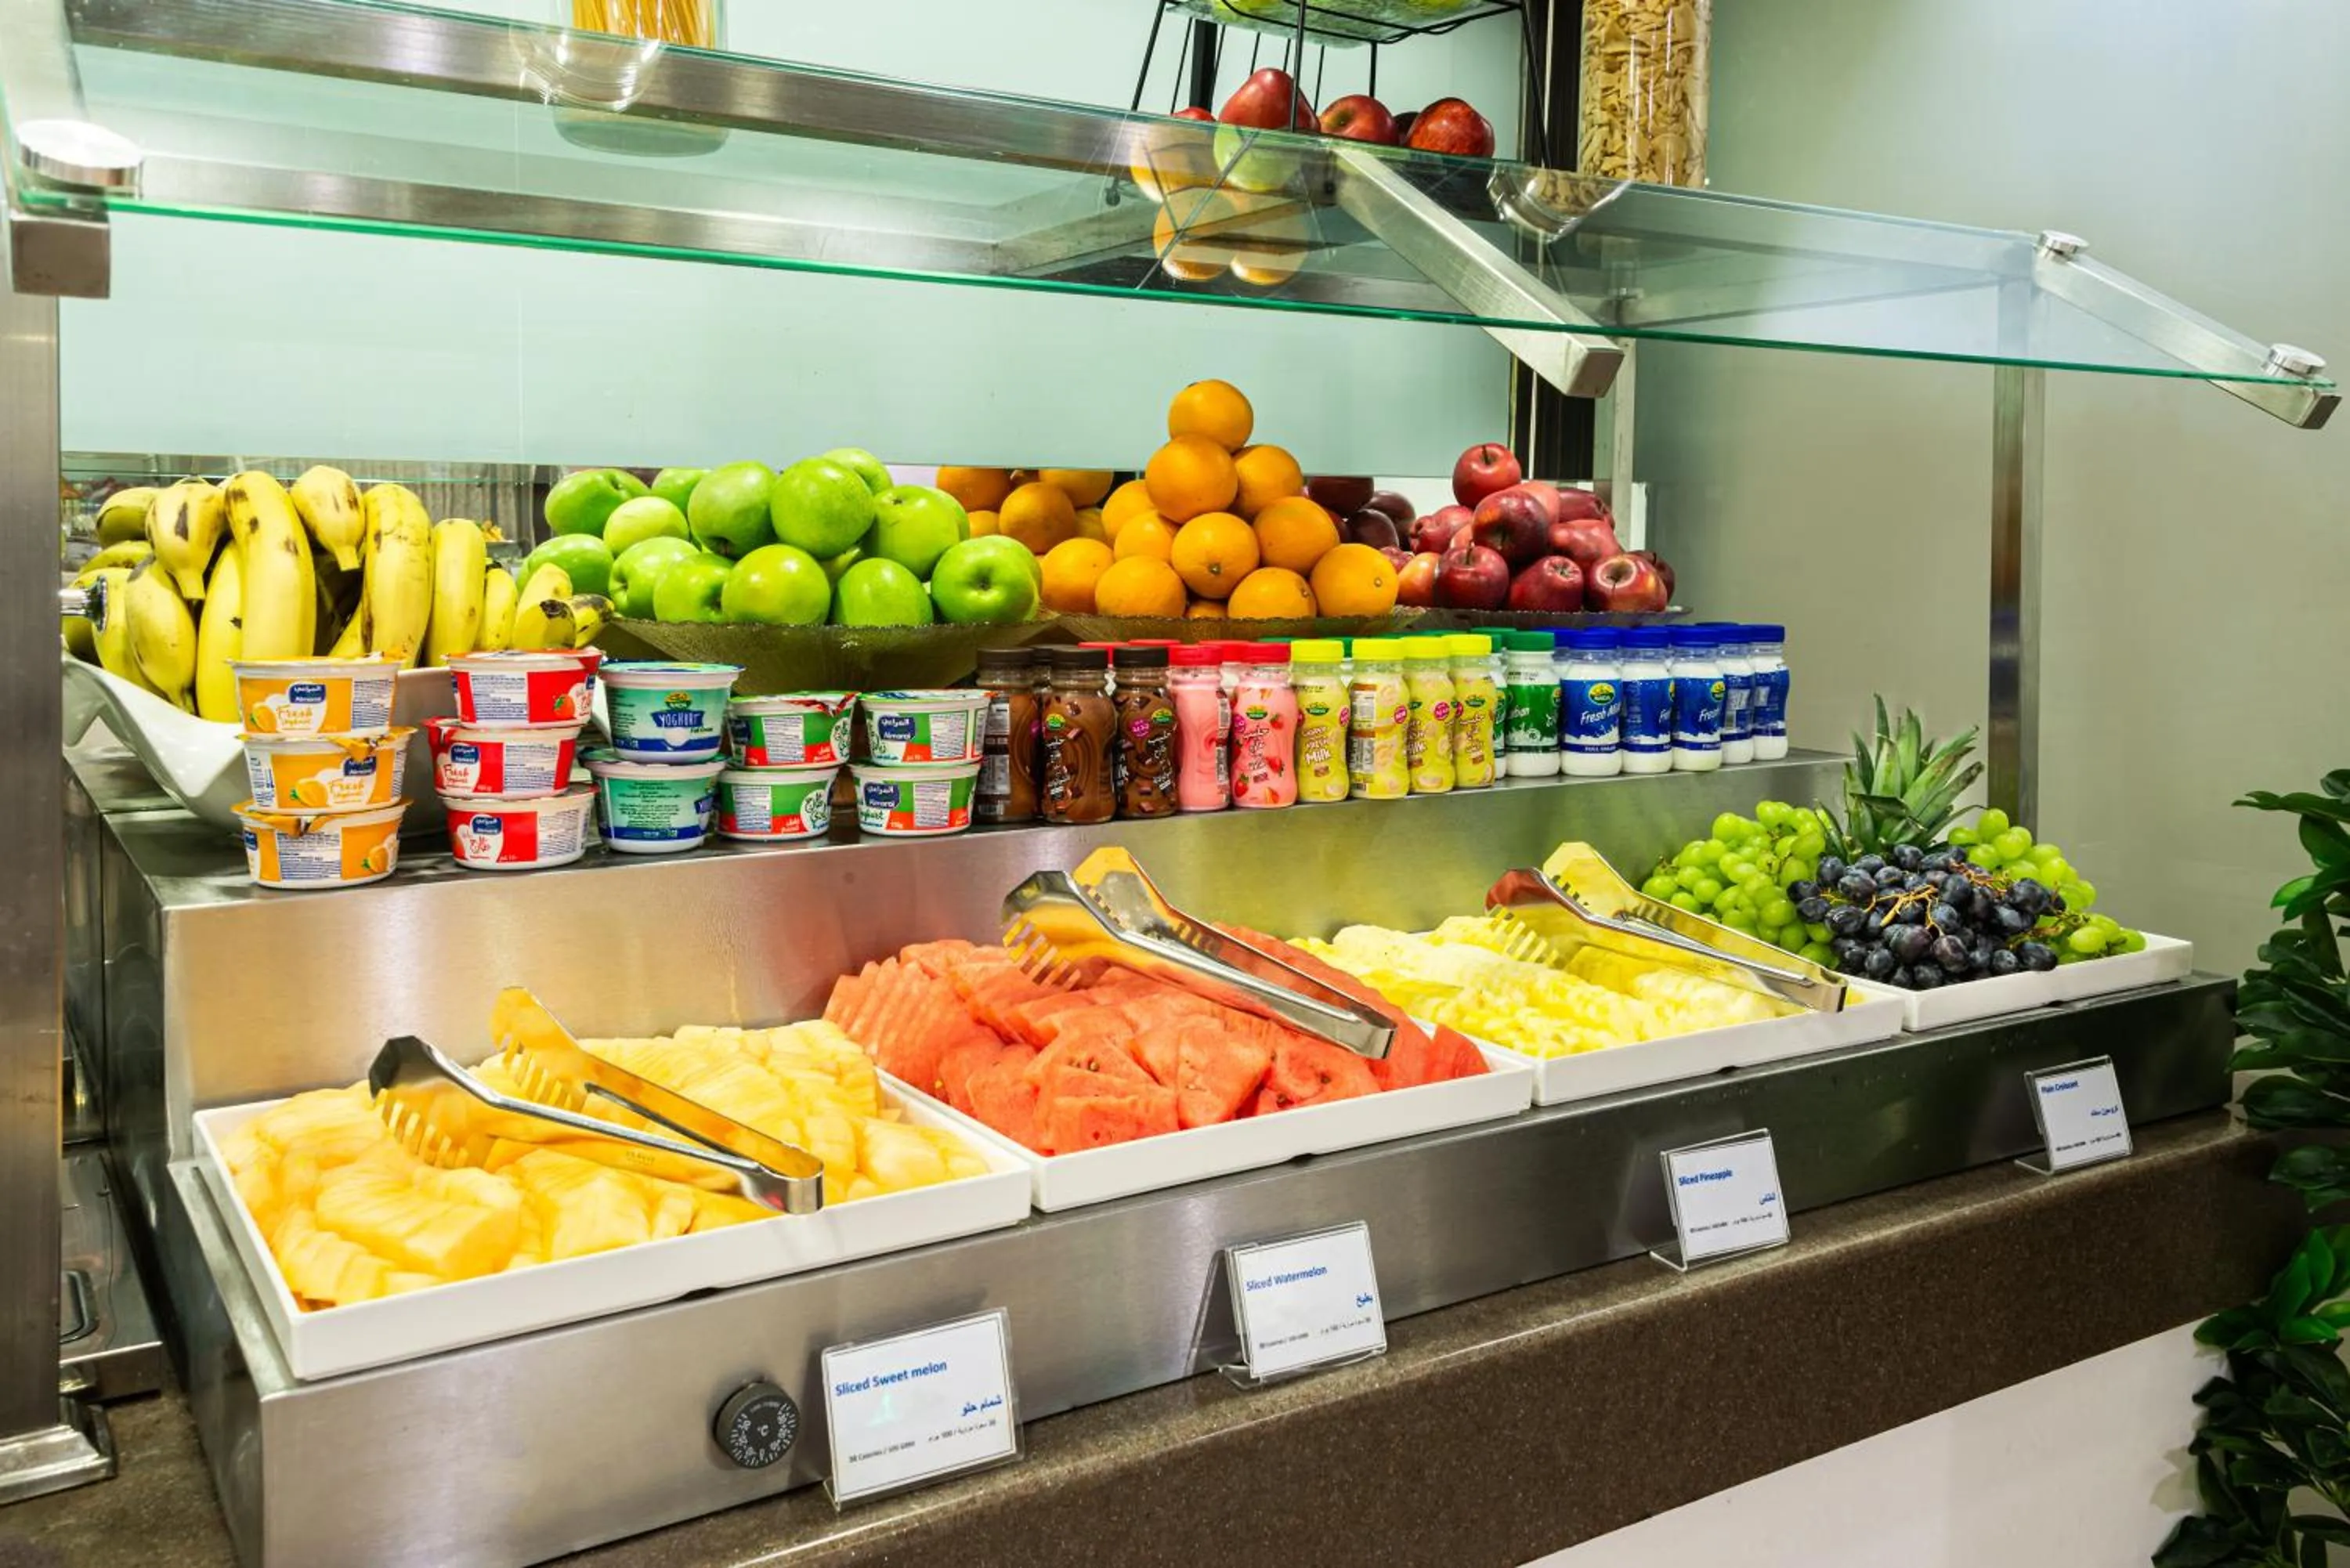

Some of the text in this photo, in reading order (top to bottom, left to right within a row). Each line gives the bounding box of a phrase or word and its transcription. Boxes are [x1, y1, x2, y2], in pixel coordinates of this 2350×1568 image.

[658, 712, 701, 728] YOGHURT
[1581, 706, 1607, 725] Fresh
[1679, 1169, 1733, 1186] Sliced Pineapple
[1246, 1265, 1328, 1292] Sliced Watermelon
[835, 1360, 947, 1396] Sliced Sweet melon
